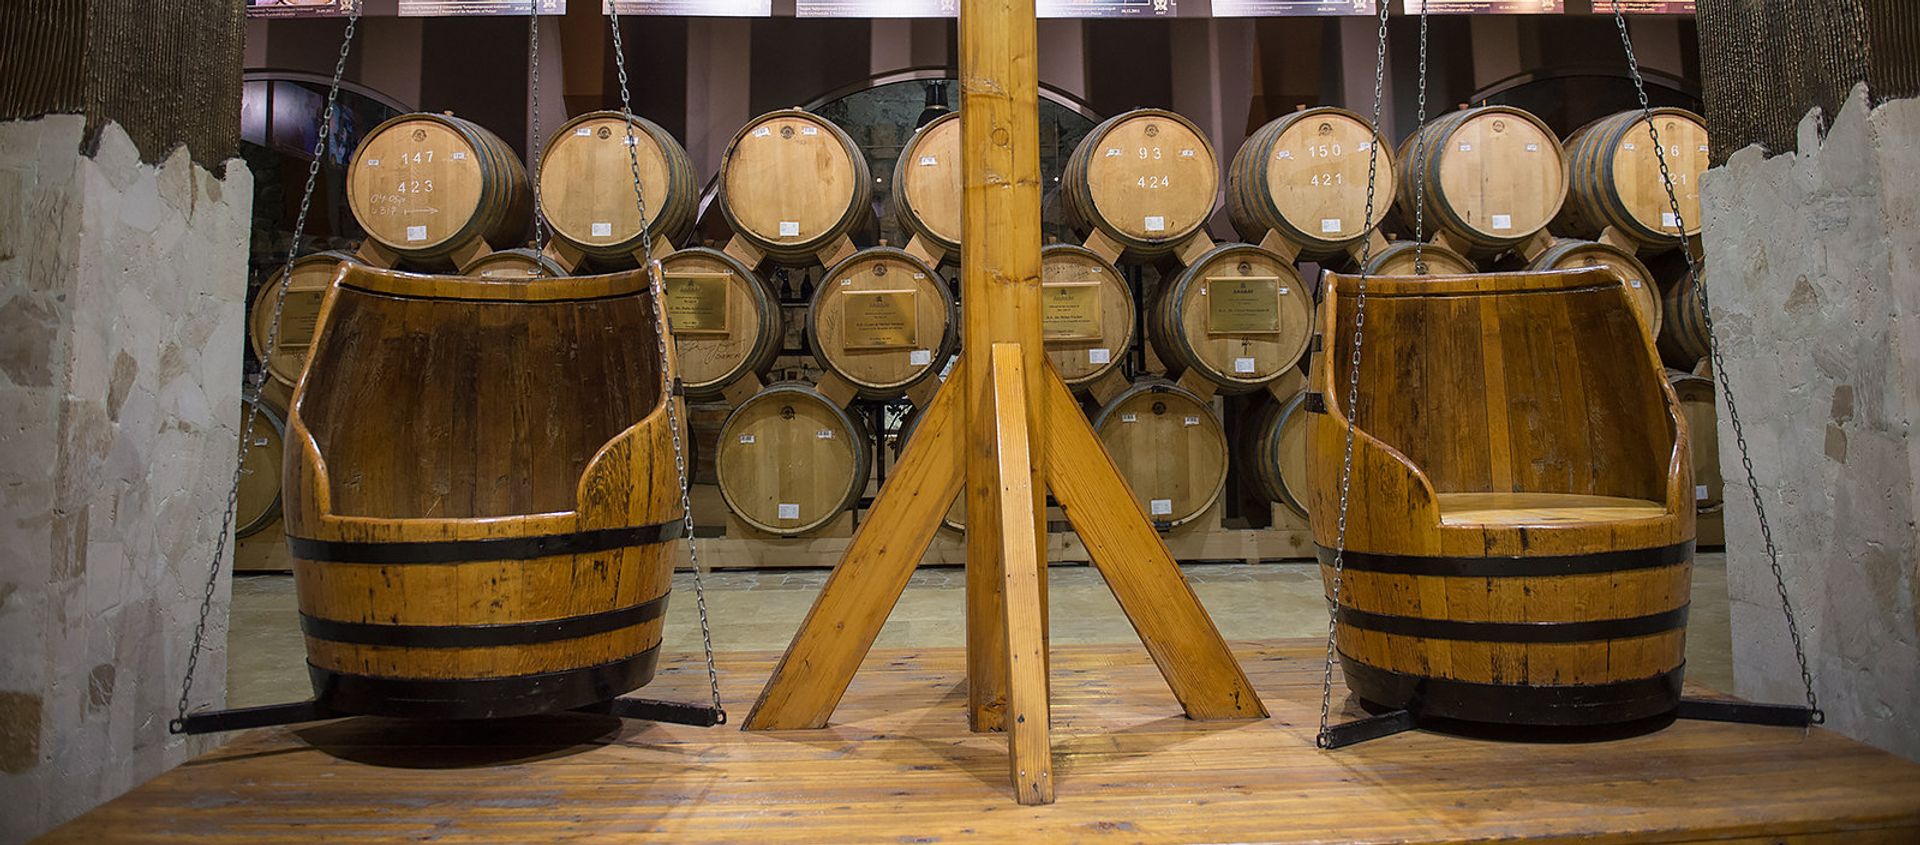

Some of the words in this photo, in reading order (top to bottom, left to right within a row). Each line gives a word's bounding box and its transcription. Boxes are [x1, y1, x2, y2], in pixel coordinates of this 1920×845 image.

[401, 150, 434, 165] 147
[1138, 147, 1162, 160] 93
[1308, 143, 1342, 158] 150
[397, 179, 434, 194] 423
[1137, 175, 1170, 189] 424
[1310, 172, 1344, 187] 421
